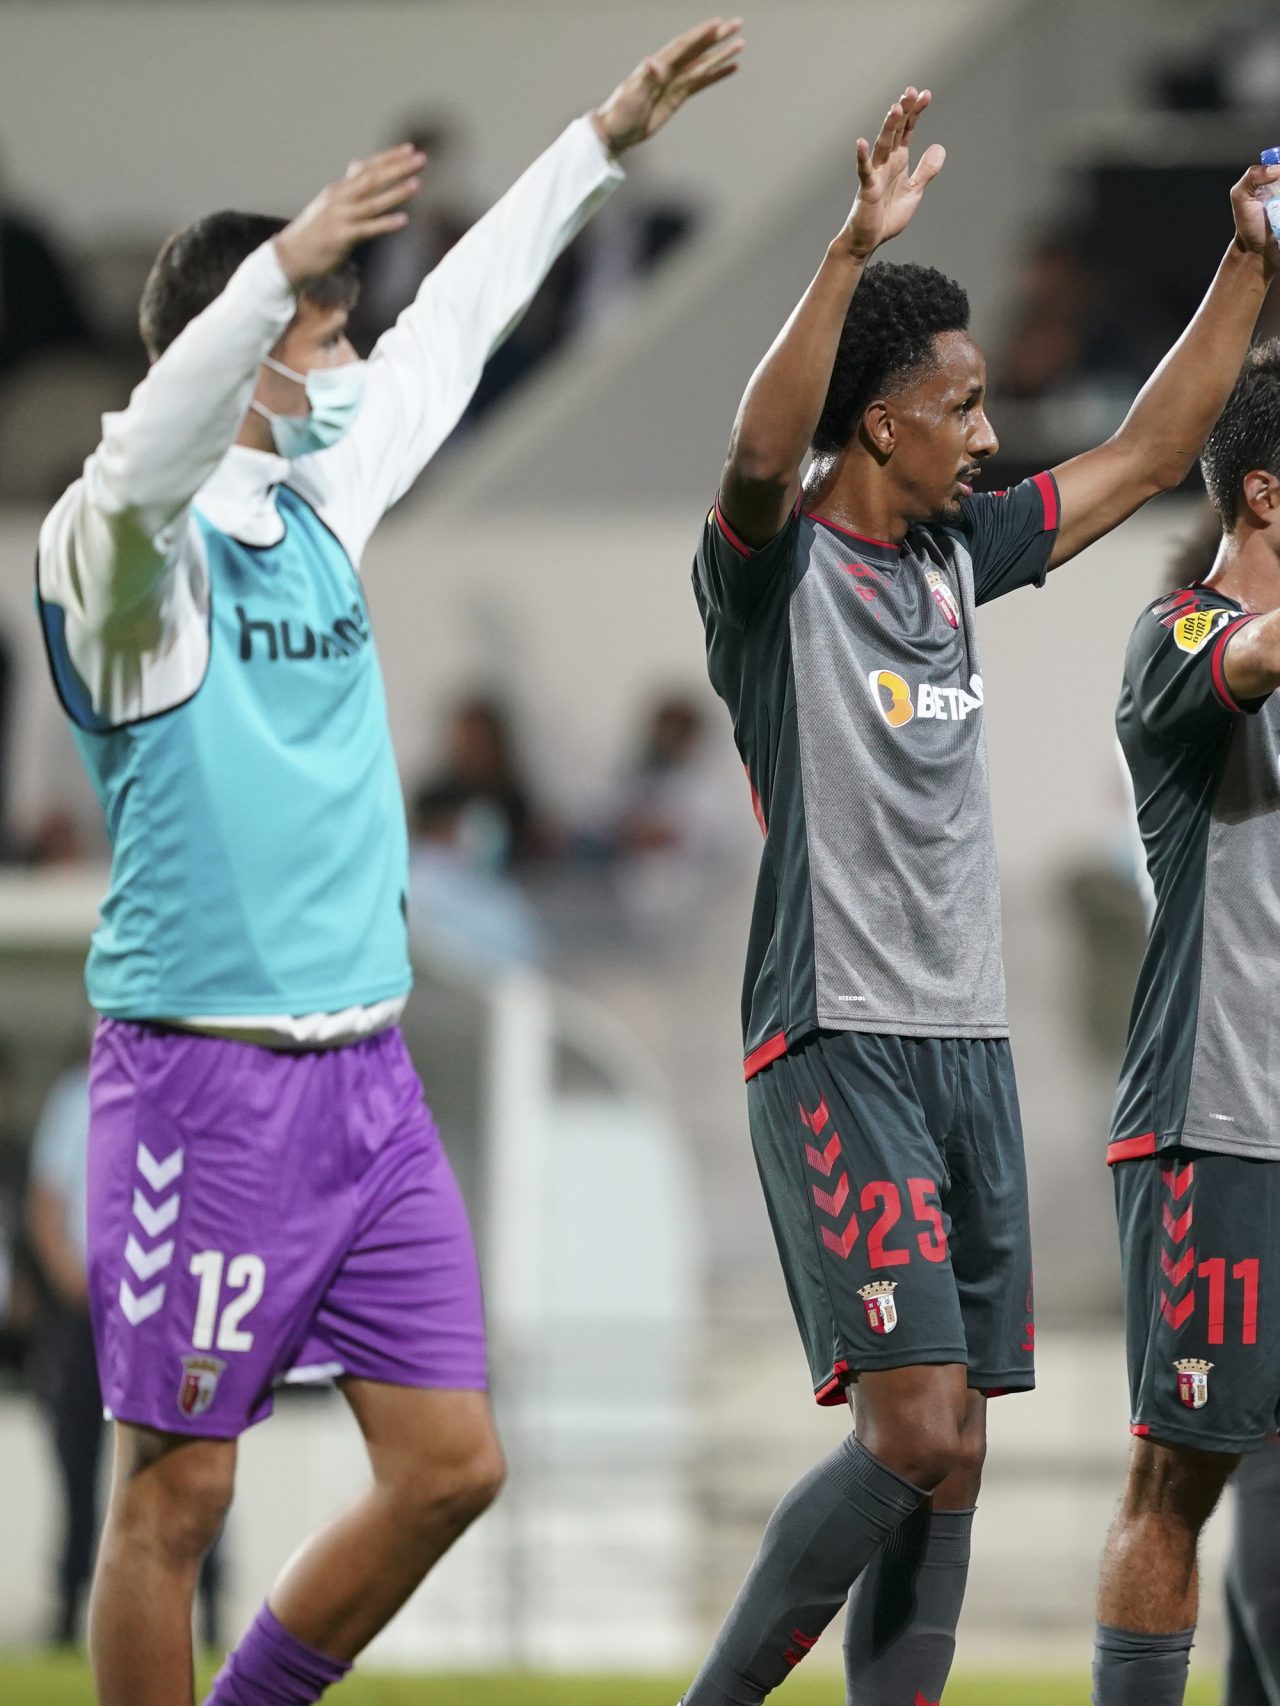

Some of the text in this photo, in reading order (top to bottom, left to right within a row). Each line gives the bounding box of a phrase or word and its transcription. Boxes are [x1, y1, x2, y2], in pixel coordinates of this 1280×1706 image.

[1184, 617, 1196, 641] LIGA
[860, 1177, 948, 1269] 25
[189, 1249, 266, 1353] 12
[1197, 1258, 1260, 1345] 11
